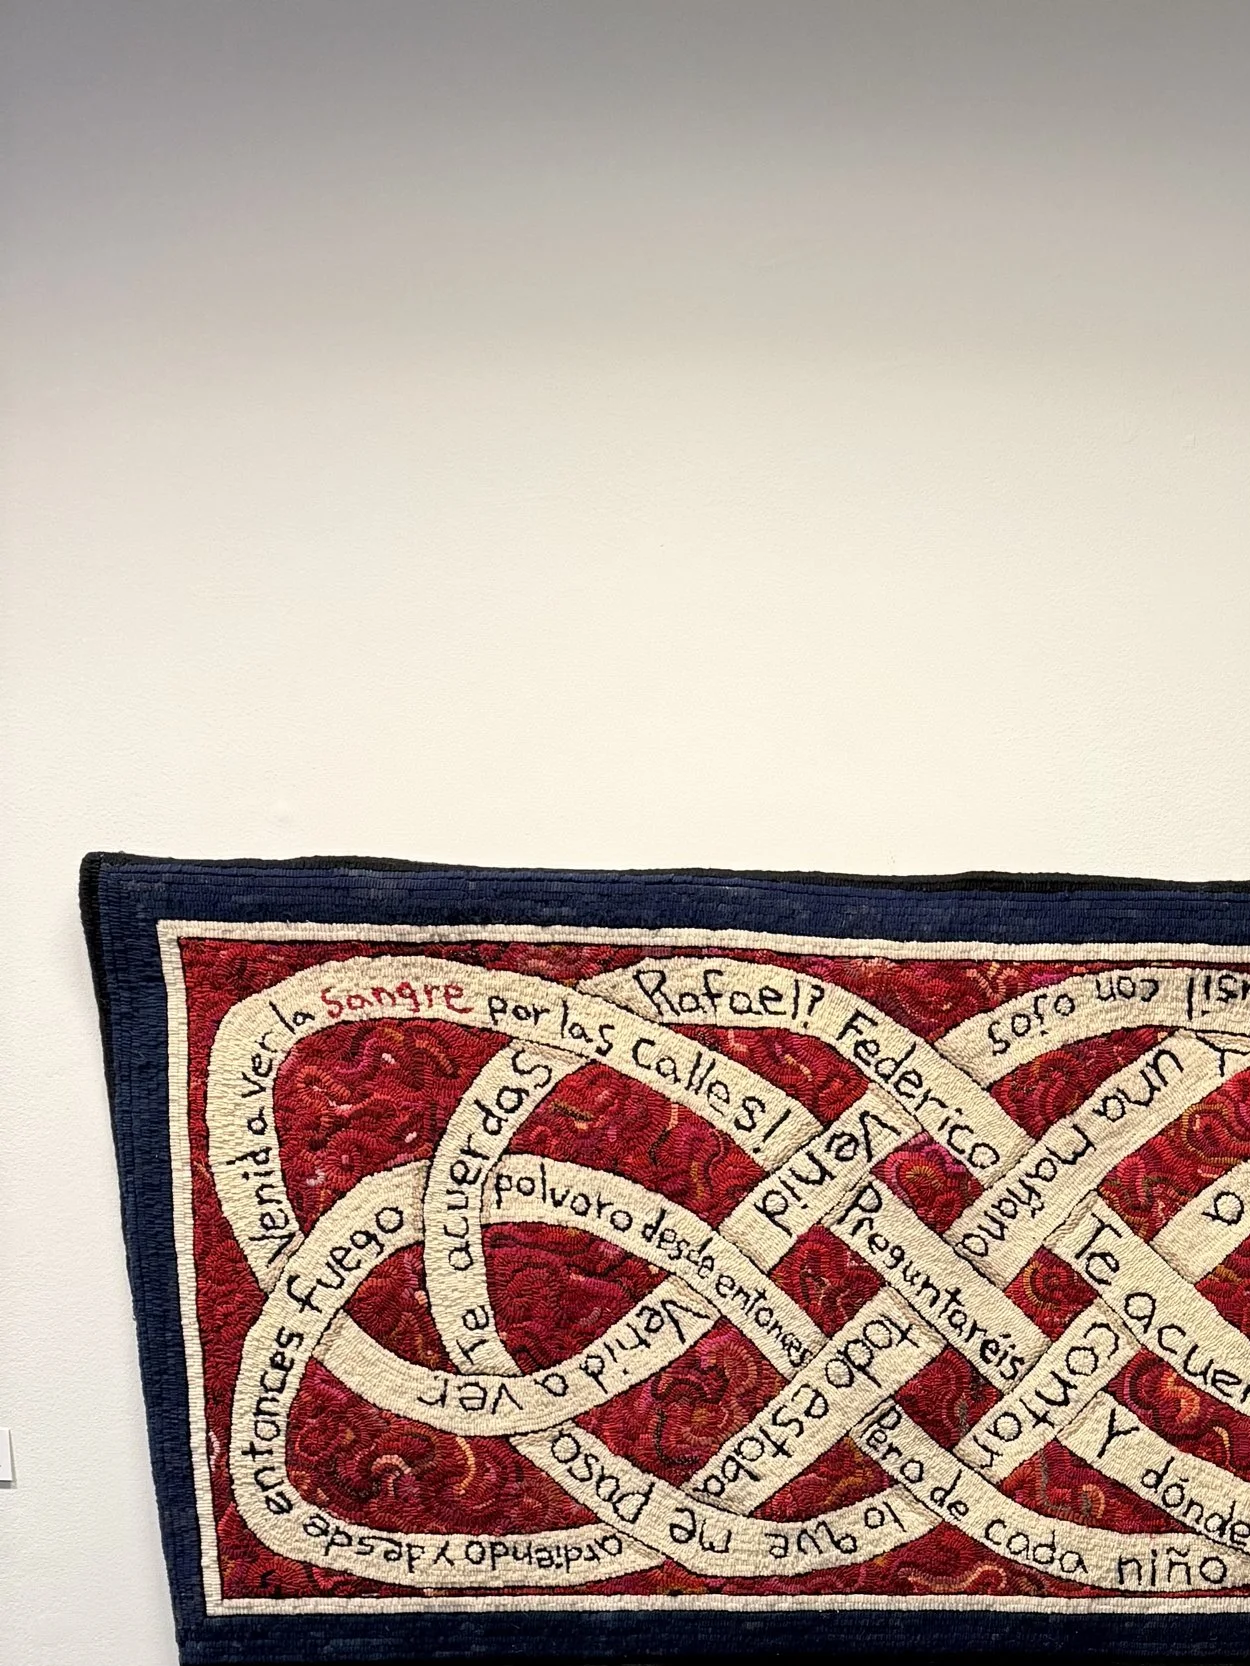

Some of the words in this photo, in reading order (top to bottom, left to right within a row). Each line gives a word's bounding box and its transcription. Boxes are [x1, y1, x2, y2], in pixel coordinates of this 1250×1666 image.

[269, 1000, 315, 1035] la
[488, 995, 551, 1025] por
[1095, 976, 1160, 1003] con
[561, 1000, 616, 1057] las
[987, 992, 1076, 1056] ojos
[241, 1032, 279, 1099] ver
[633, 969, 825, 1030] Rafael?
[836, 1007, 1001, 1169] Federico
[1092, 1048, 1184, 1123] una
[246, 1107, 269, 1136] a
[753, 1110, 901, 1238] Venid
[954, 1123, 1097, 1257] mañana
[226, 1146, 297, 1268] Venid
[1202, 1190, 1245, 1226] a
[286, 1206, 404, 1315] fuego
[1075, 1212, 1122, 1286] Te
[641, 1207, 716, 1280] desde
[714, 1273, 815, 1369] entonces
[836, 1181, 1026, 1381] Preguntaréis
[456, 1304, 490, 1366] Te
[580, 1298, 712, 1395] Venid
[825, 1314, 920, 1389] todo
[417, 1376, 524, 1416] ver
[533, 1372, 569, 1398] a
[693, 1384, 830, 1499] estaba
[1097, 1408, 1141, 1460] Y
[302, 1512, 426, 1574] desde
[668, 1507, 732, 1554] me
[765, 1519, 859, 1560] que
[864, 1501, 908, 1534] lo
[930, 1468, 970, 1522] de
[984, 1518, 1089, 1575] cada
[1117, 1545, 1228, 1587] niño
[465, 1533, 623, 1571] ardiendo
